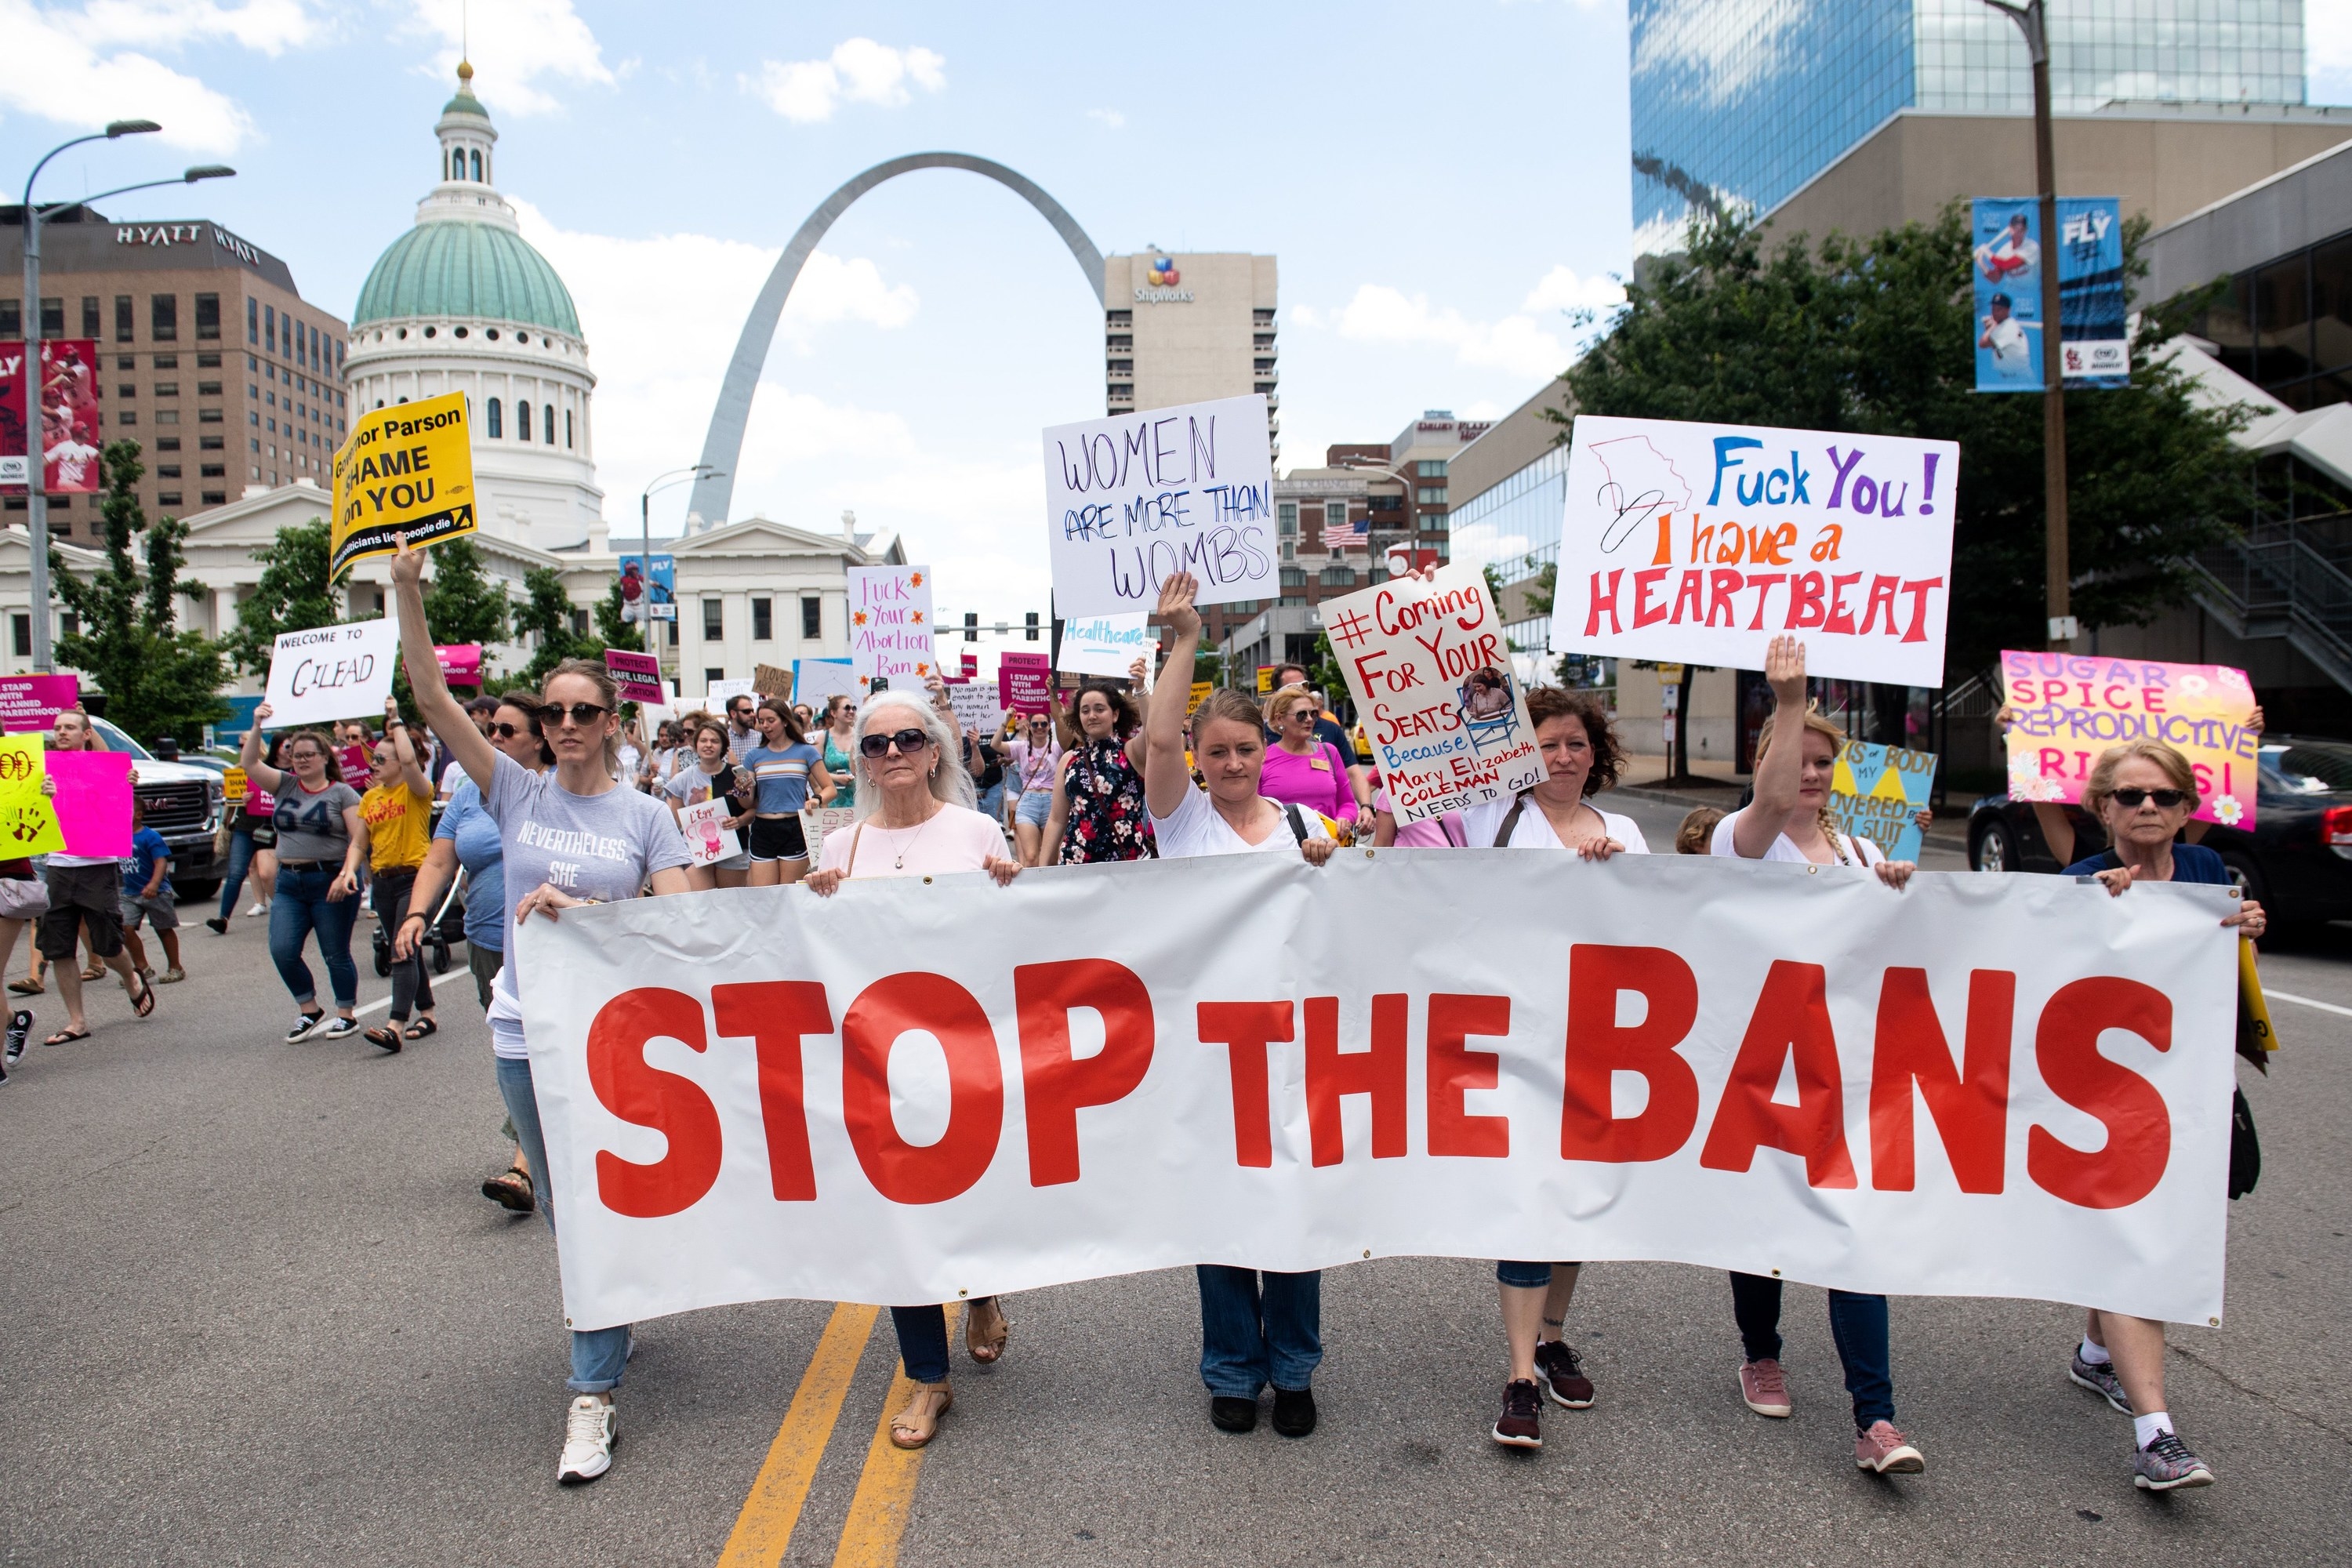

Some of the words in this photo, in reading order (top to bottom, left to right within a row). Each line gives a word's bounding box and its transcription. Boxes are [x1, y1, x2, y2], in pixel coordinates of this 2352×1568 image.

[117, 225, 201, 247] HYATT
[213, 227, 260, 265] HYATT
[2062, 215, 2112, 246] FLY
[1134, 288, 1194, 306] ShipWorks
[0, 355, 22, 376] LY
[336, 427, 379, 479] Governor
[384, 409, 460, 438] Parson
[1058, 416, 1215, 492] WOMEN
[346, 445, 430, 498] SHAME
[1707, 436, 1810, 506] Fuck
[344, 499, 362, 527] on
[367, 477, 435, 513] YOU
[1065, 503, 1117, 542] ARE
[1124, 490, 1195, 536] MORE
[1203, 480, 1270, 522] THAN
[404, 524, 435, 541] people
[435, 518, 451, 531] die
[1651, 512, 1671, 566] I
[1691, 513, 1798, 566] have
[1809, 524, 1842, 562] a
[652, 560, 670, 571] FLY
[1110, 525, 1269, 599] WOMBS
[862, 575, 909, 606] Fuck
[1584, 566, 1944, 643] HEARTBEAT
[872, 605, 911, 626] Your
[281, 632, 336, 649] WELCOME
[347, 630, 362, 639] TO
[856, 630, 930, 652] Abortion
[1065, 618, 1144, 646] Healthcare
[292, 655, 374, 697] GILEAD
[615, 657, 648, 669] PROTECT
[764, 667, 789, 684] LOVE
[877, 654, 911, 677] Ban
[1354, 650, 1425, 699] FOR
[1415, 626, 1505, 682] YOUR
[2009, 652, 2170, 688] SUGAR
[2, 683, 33, 691] STAND
[633, 673, 658, 684] LEGAL
[1011, 687, 1047, 695] PLANNED
[0, 691, 24, 700] WITH
[0, 699, 42, 709] PLANNED
[952, 692, 975, 703] enough
[1011, 694, 1051, 702] PARENTHO
[2012, 680, 2166, 713] SPICE
[0, 707, 62, 717] PARENTHOOD
[980, 711, 994, 720] her
[1374, 702, 1462, 745] SEATS
[2006, 702, 2259, 760] REPRODUCTIVE
[1382, 735, 1468, 769] Because
[1884, 745, 1939, 776] BODY
[1386, 769, 1443, 797] Mary
[1449, 741, 1535, 777] Elizabeth
[1859, 766, 1877, 779] MY
[2038, 747, 2231, 795] RIS!
[1400, 768, 1501, 807] COLEMAN
[1406, 793, 1471, 822] NEEDS
[1482, 788, 1497, 802] TO
[1508, 767, 1541, 791] GO!
[274, 798, 332, 836] 64
[365, 804, 406, 826] OWER
[1827, 789, 1907, 820] OVERED
[517, 820, 629, 866] NEVERTHELESS,
[809, 825, 819, 863] WITH
[1860, 819, 1906, 844] SUIT
[549, 861, 581, 887] SHE
[586, 957, 1155, 1218] STOP
[1196, 993, 1510, 1168] THE
[1561, 943, 2173, 1210] BANS
